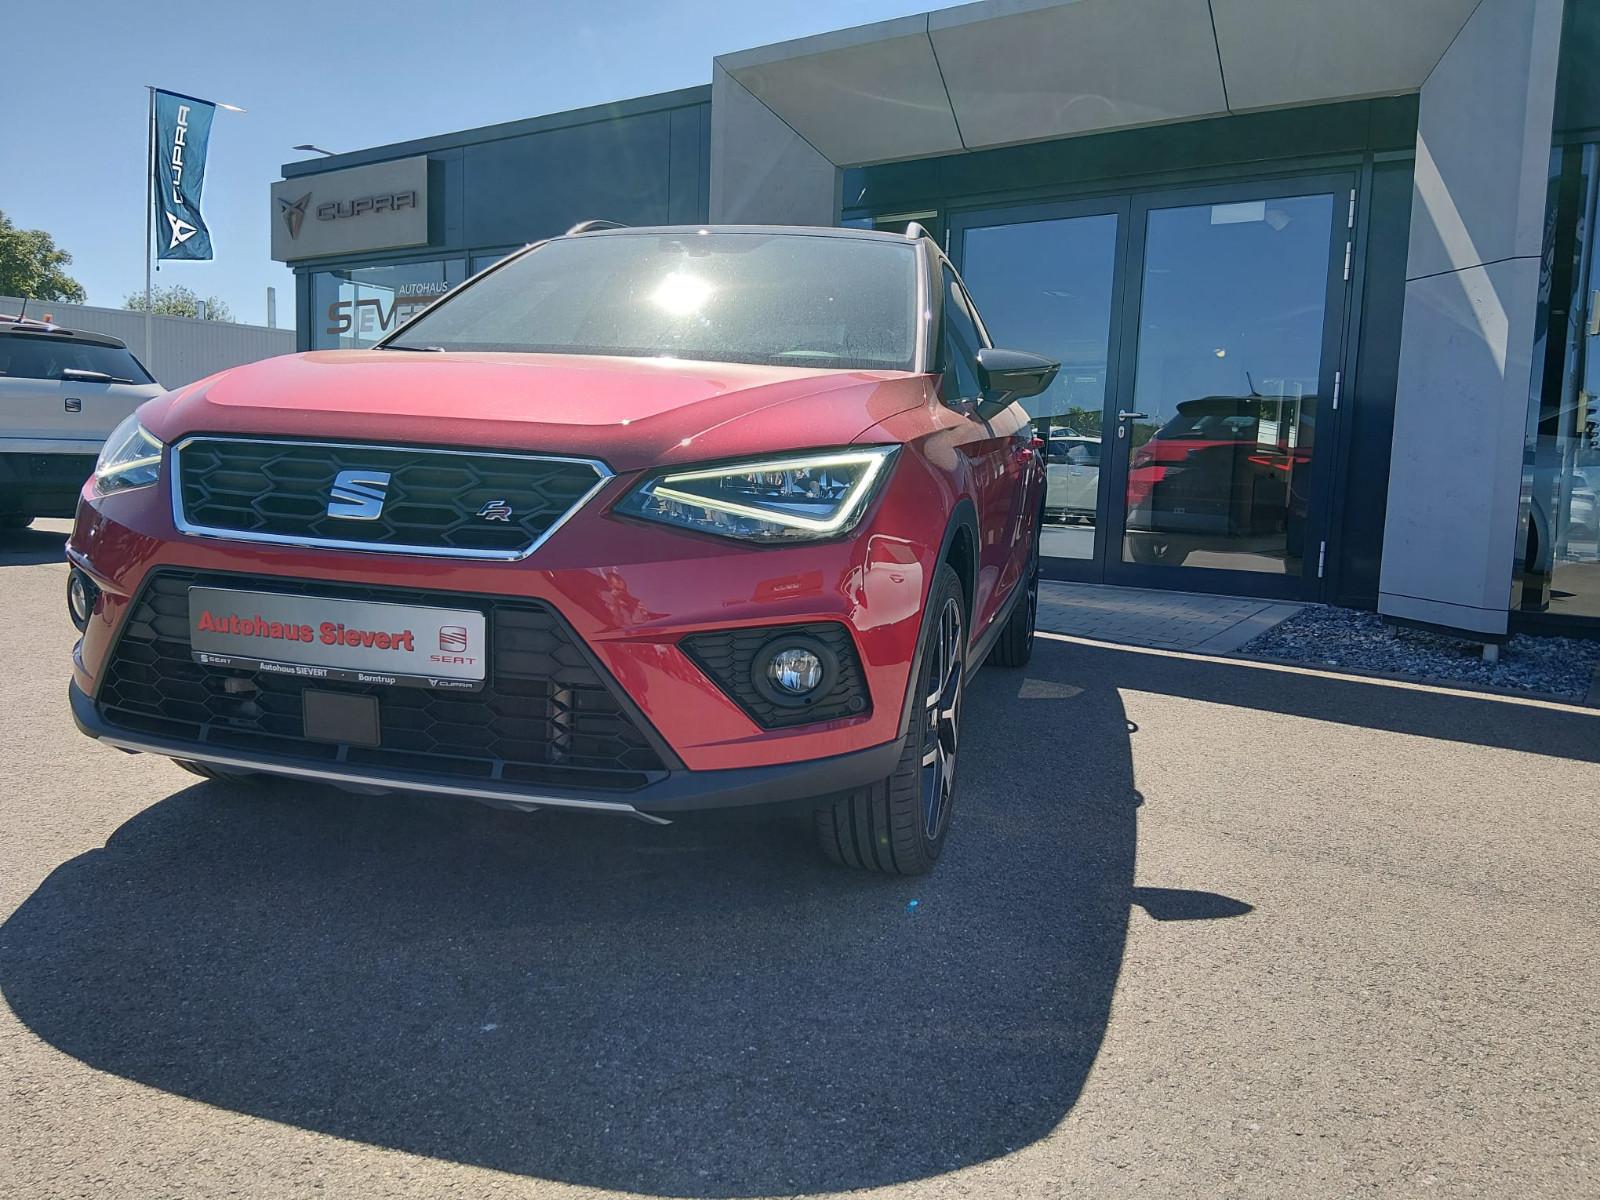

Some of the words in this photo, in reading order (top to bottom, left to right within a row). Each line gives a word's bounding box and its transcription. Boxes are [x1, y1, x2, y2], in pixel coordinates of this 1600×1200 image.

[172, 105, 190, 204] CUPRA
[316, 190, 418, 222] CUPRA
[399, 281, 448, 295] AUTOHAUS
[198, 609, 314, 643] Autohaus
[319, 621, 415, 652] Sievert
[208, 656, 232, 665] SEAT
[430, 654, 477, 665] SEAT
[259, 662, 296, 674] Autohaus
[296, 667, 329, 677] SIEVERT
[358, 673, 396, 685] Barntrup
[439, 681, 473, 689] CUPRA
